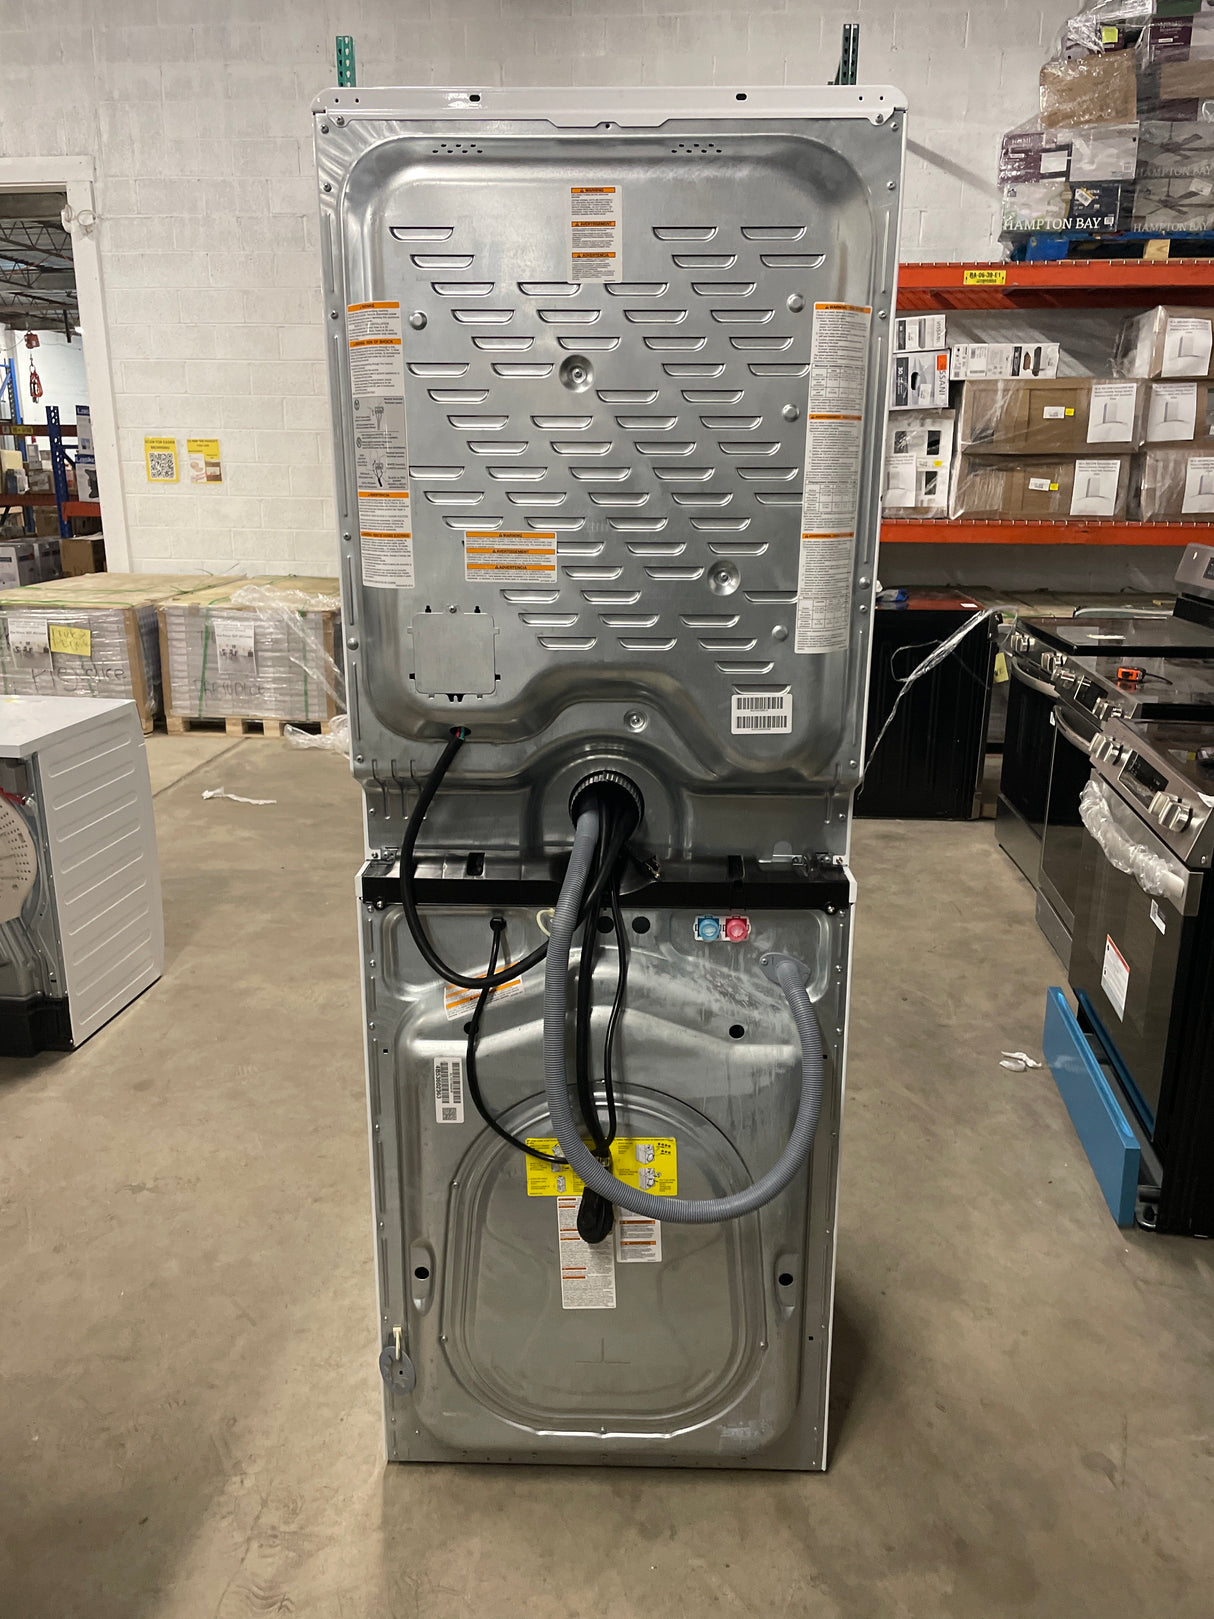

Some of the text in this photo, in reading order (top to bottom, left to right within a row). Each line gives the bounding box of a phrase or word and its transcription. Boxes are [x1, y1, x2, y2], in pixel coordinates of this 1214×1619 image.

[1003, 216, 1102, 232] HAMPTON BAY
[1133, 222, 1209, 233] HAMPTON BAY
[938, 370, 946, 397] SSANI
